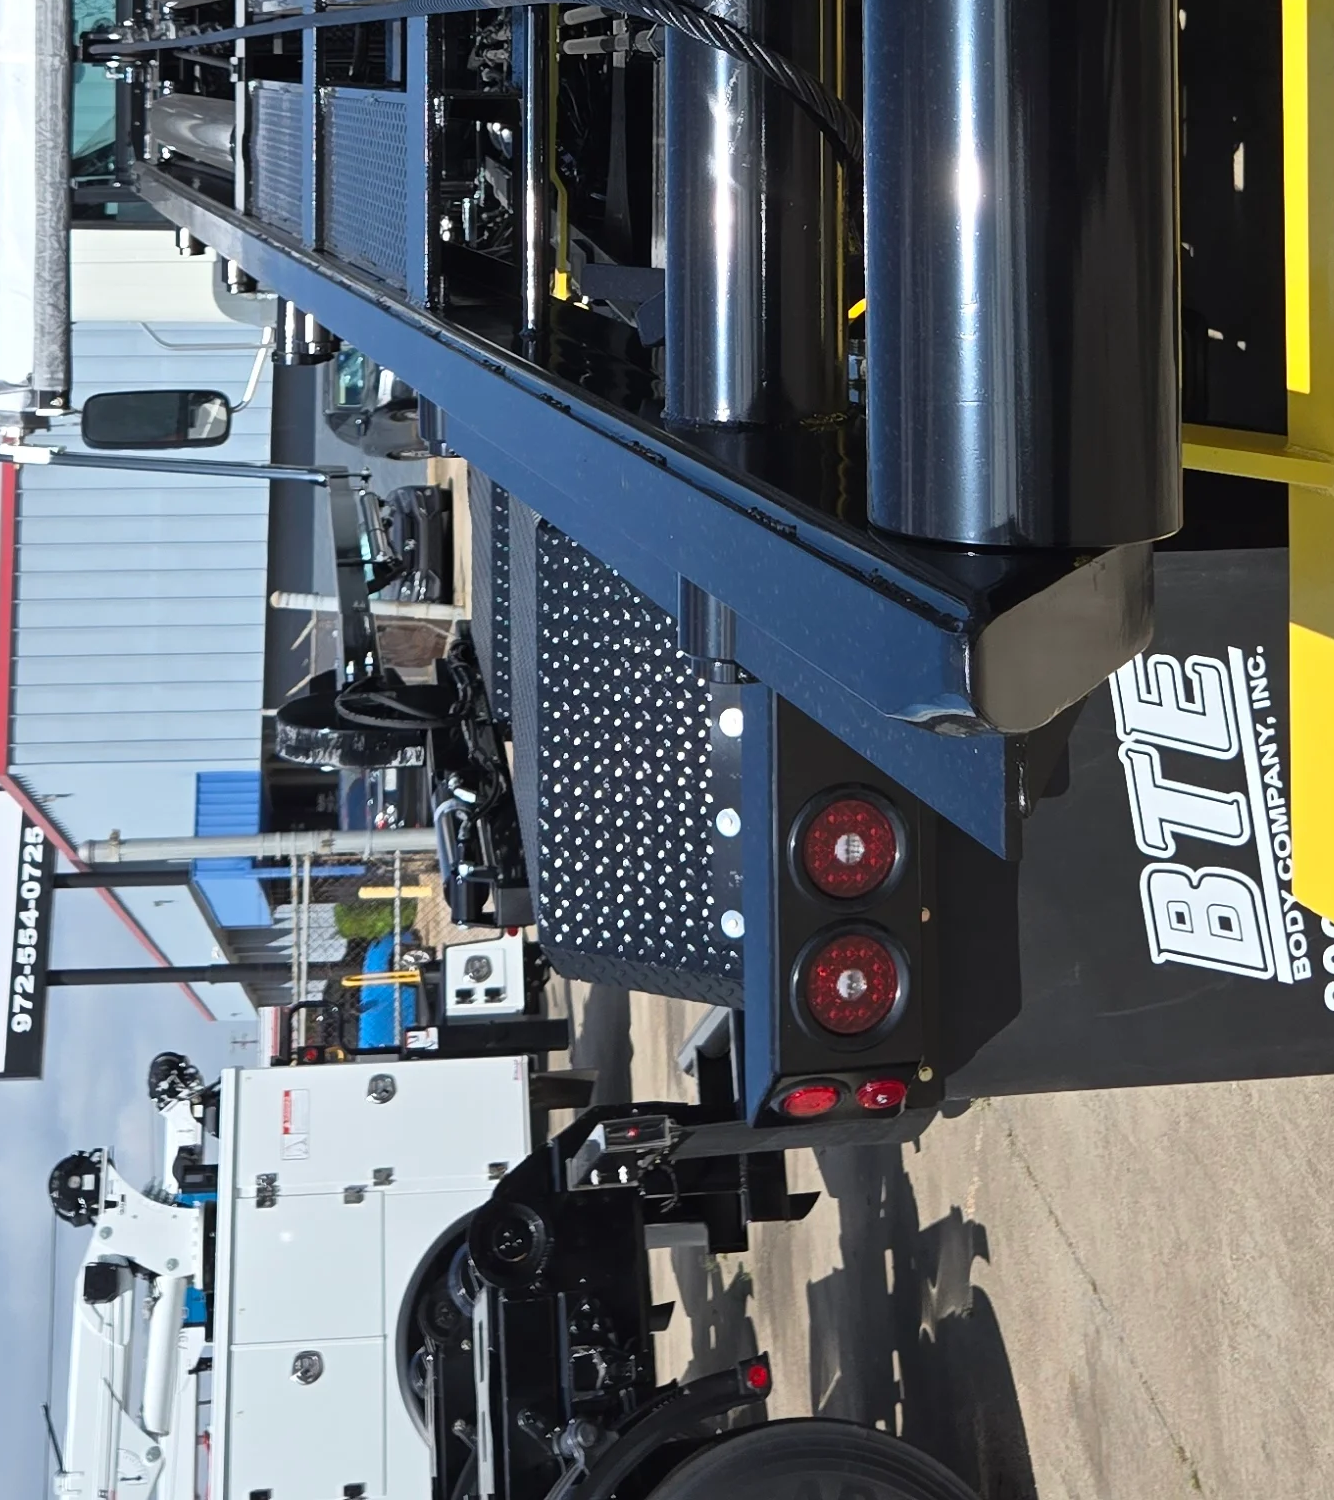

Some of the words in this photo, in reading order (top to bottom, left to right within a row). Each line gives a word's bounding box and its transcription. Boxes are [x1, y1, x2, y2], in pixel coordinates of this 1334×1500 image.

[1247, 645, 1271, 709] INC.
[1108, 653, 1275, 980] BTE
[1256, 717, 1293, 881] COMPANY,
[11, 825, 44, 1033] 972-554-0725
[1281, 890, 1312, 980] BODY
